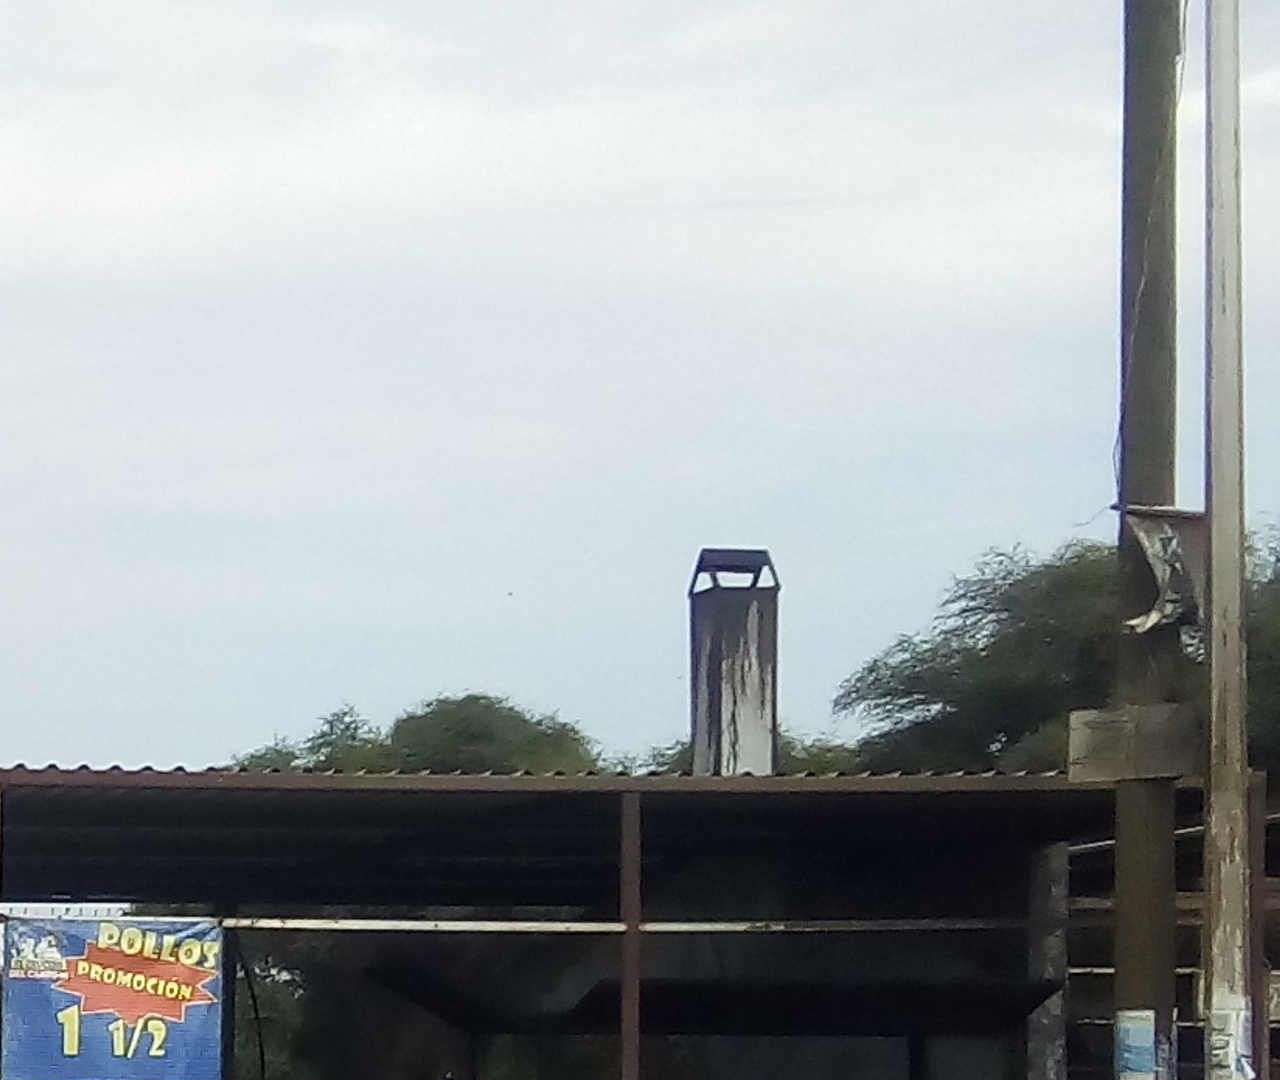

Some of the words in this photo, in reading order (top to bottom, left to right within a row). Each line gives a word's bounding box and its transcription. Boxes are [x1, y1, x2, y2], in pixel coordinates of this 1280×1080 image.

[97, 920, 220, 968] POLLOS
[77, 960, 192, 1000] PROMOCIÓN
[56, 1005, 80, 1056] 1
[108, 1018, 168, 1060] 1/2
